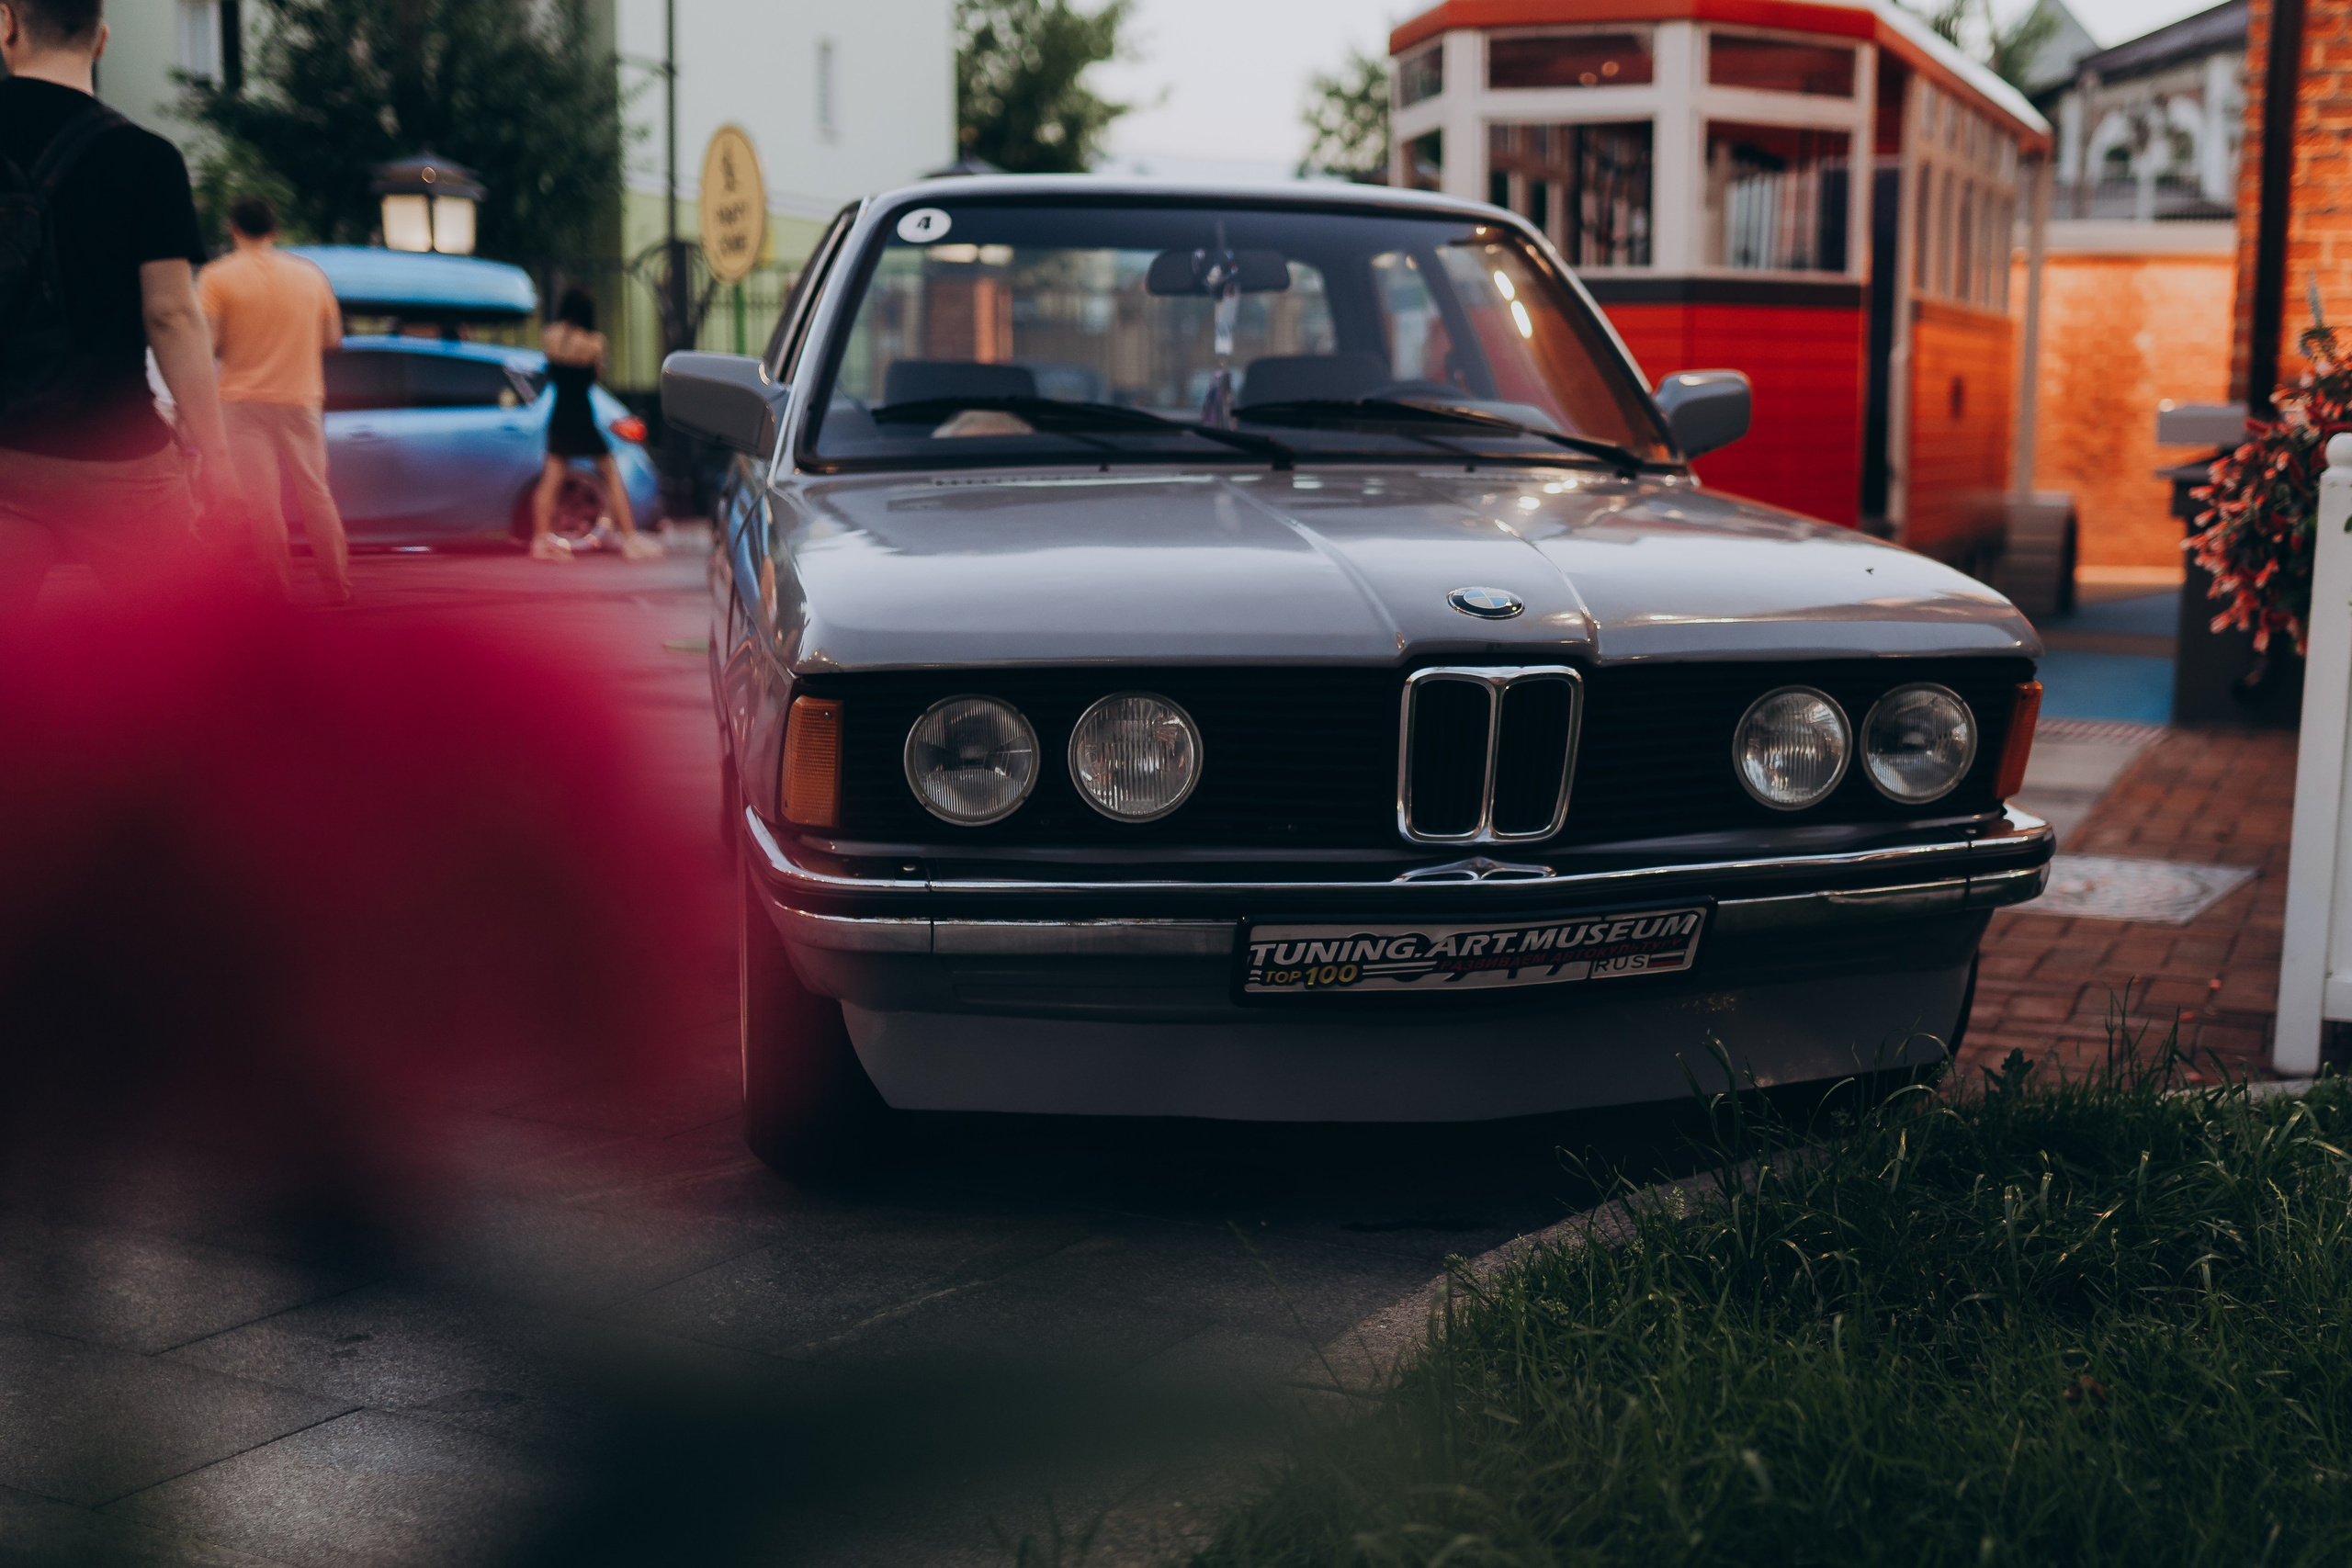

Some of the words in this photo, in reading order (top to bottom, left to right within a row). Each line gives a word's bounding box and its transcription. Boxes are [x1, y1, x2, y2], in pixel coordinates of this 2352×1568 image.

[1250, 914, 1698, 966] TUNING.ART.MUSEUM
[1439, 952, 1547, 972] РАЗВИВАЕМ
[1595, 955, 1646, 972] RUS
[1264, 970, 1303, 984] TOP
[1305, 964, 1359, 986] 100
